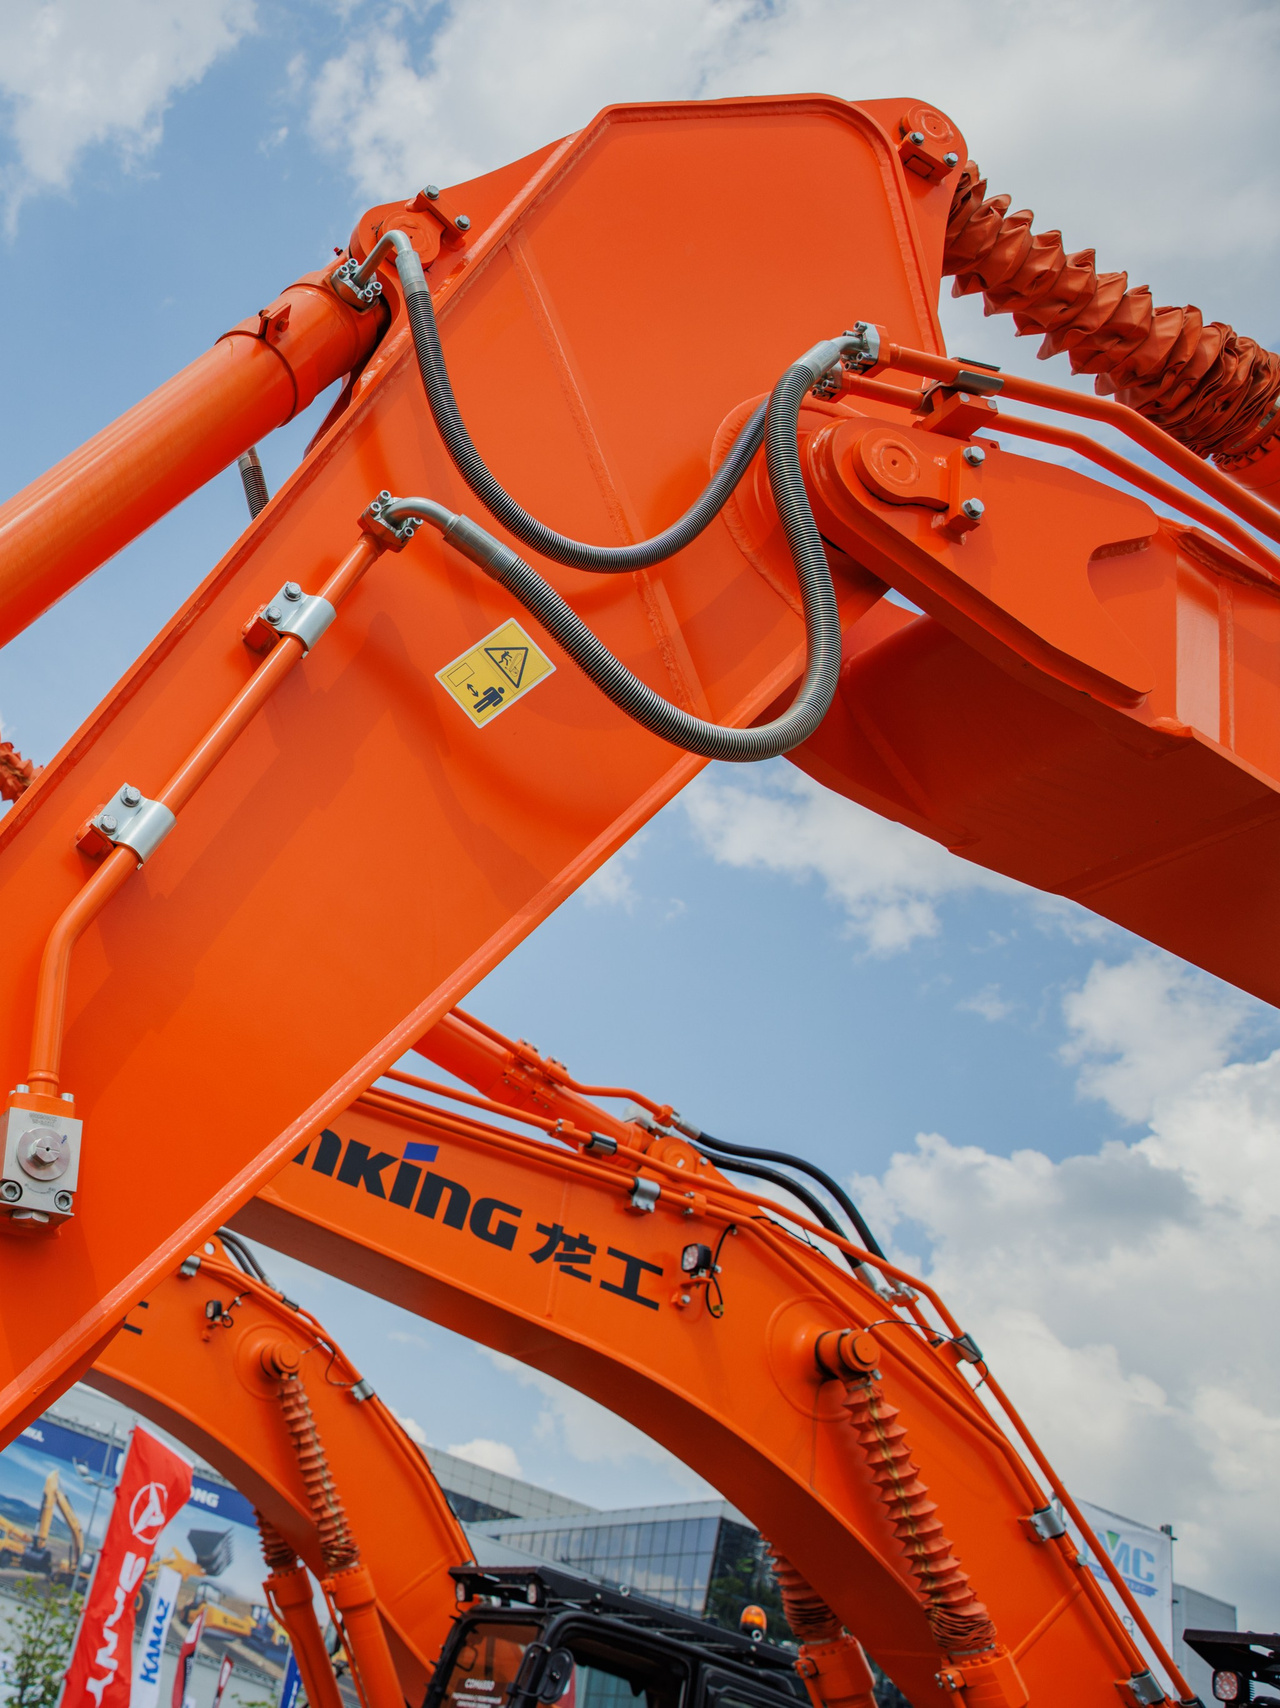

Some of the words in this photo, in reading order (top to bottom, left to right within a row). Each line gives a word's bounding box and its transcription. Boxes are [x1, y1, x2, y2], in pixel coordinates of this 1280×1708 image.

[528, 1221, 664, 1312] 龙工
[85, 1551, 147, 1708] SANY
[139, 1597, 171, 1685] KAMAZ
